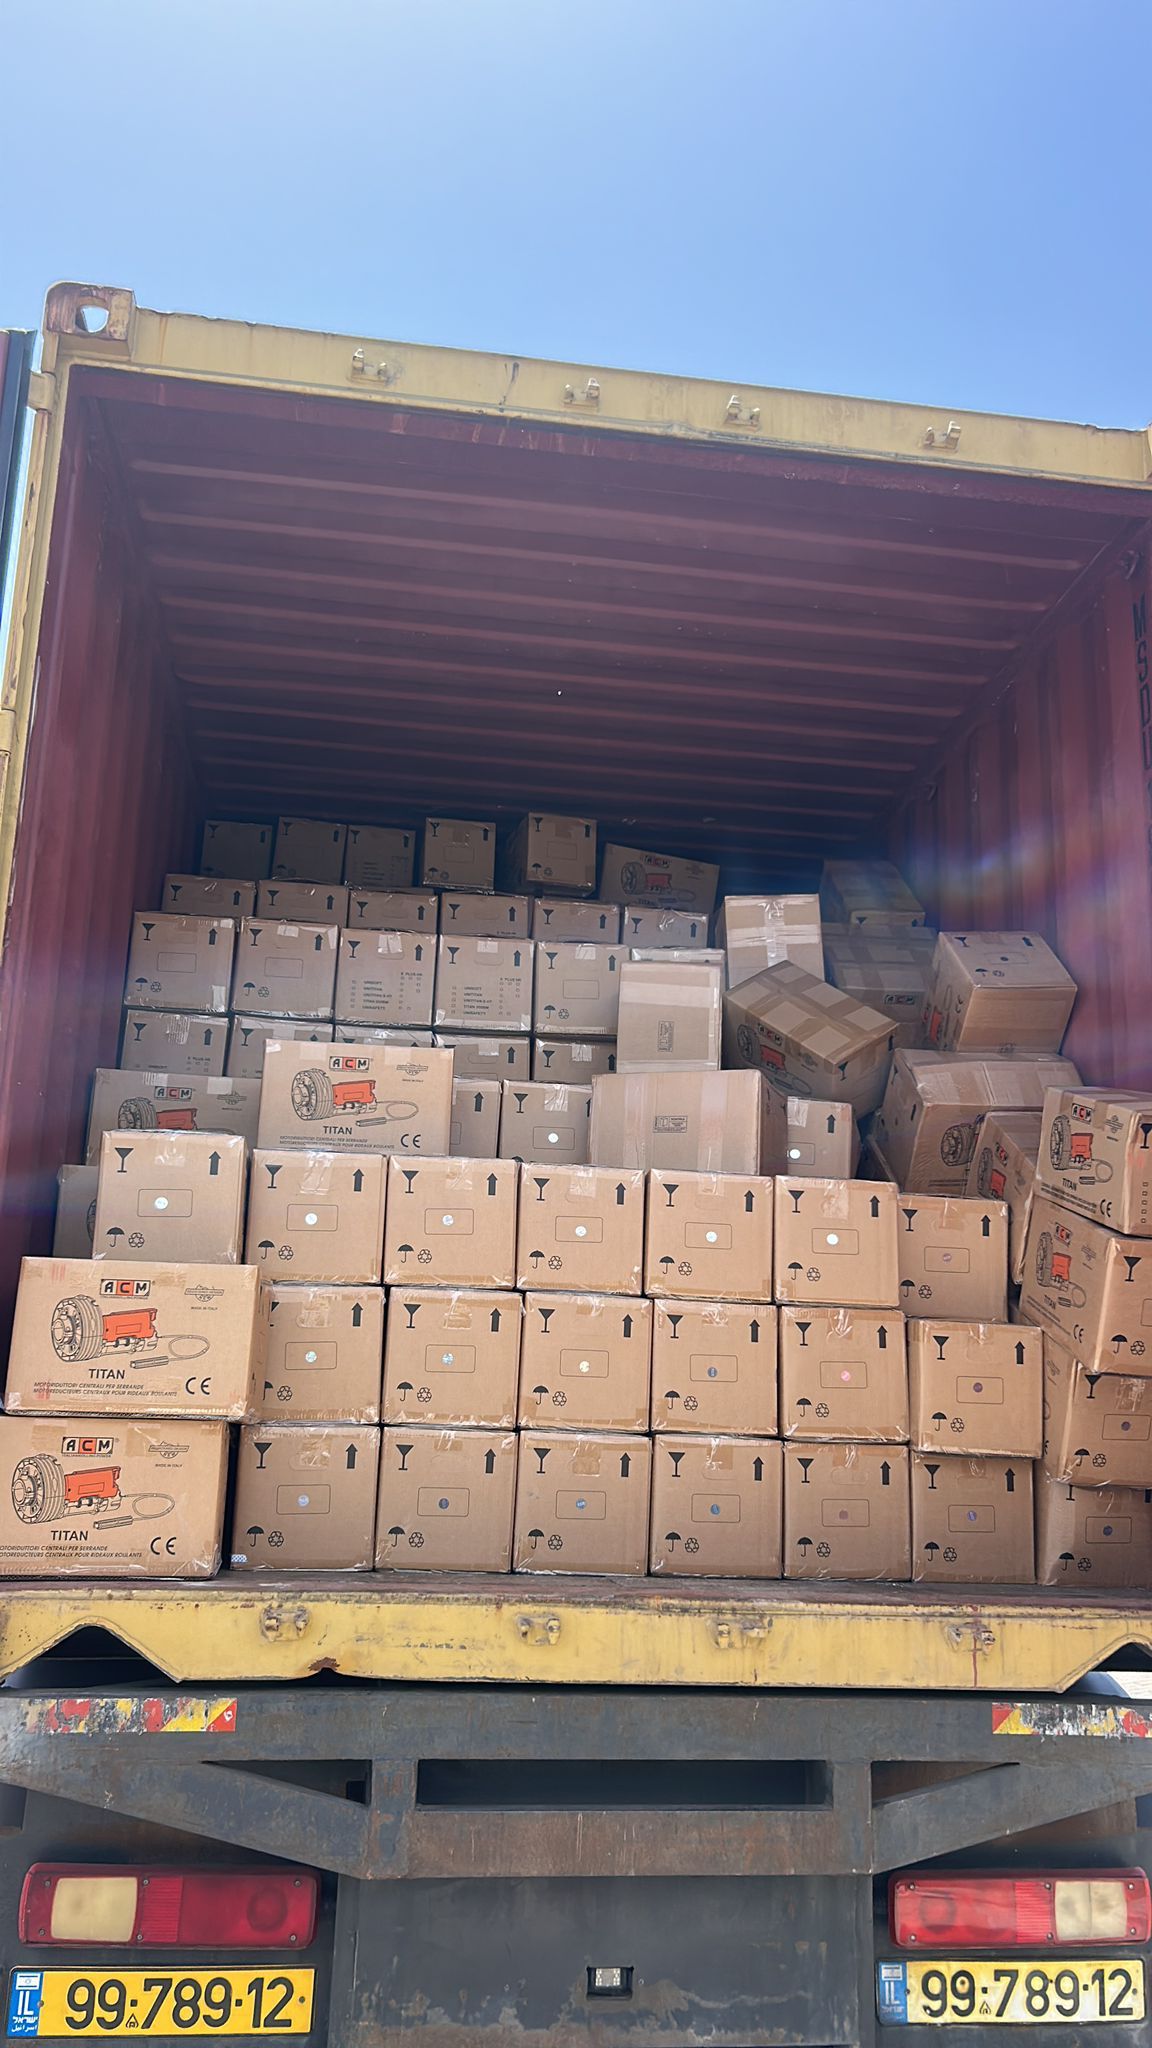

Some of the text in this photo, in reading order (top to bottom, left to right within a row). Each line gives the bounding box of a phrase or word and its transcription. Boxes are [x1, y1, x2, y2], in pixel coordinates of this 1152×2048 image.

[333, 1058, 367, 1068] ACM
[157, 1088, 190, 1098] ACM
[1073, 1105, 1091, 1120] ACM
[323, 1126, 352, 1135] TITAN
[1063, 1178, 1077, 1191] TITAN
[103, 1281, 148, 1294] ACM
[88, 1369, 126, 1379] TITAN
[66, 1440, 110, 1452] ACM
[51, 1530, 89, 1541] TITAN
[885, 1981, 900, 2005] IL
[17, 1990, 34, 2016] IL
[12, 2016, 38, 2024] ישראל
